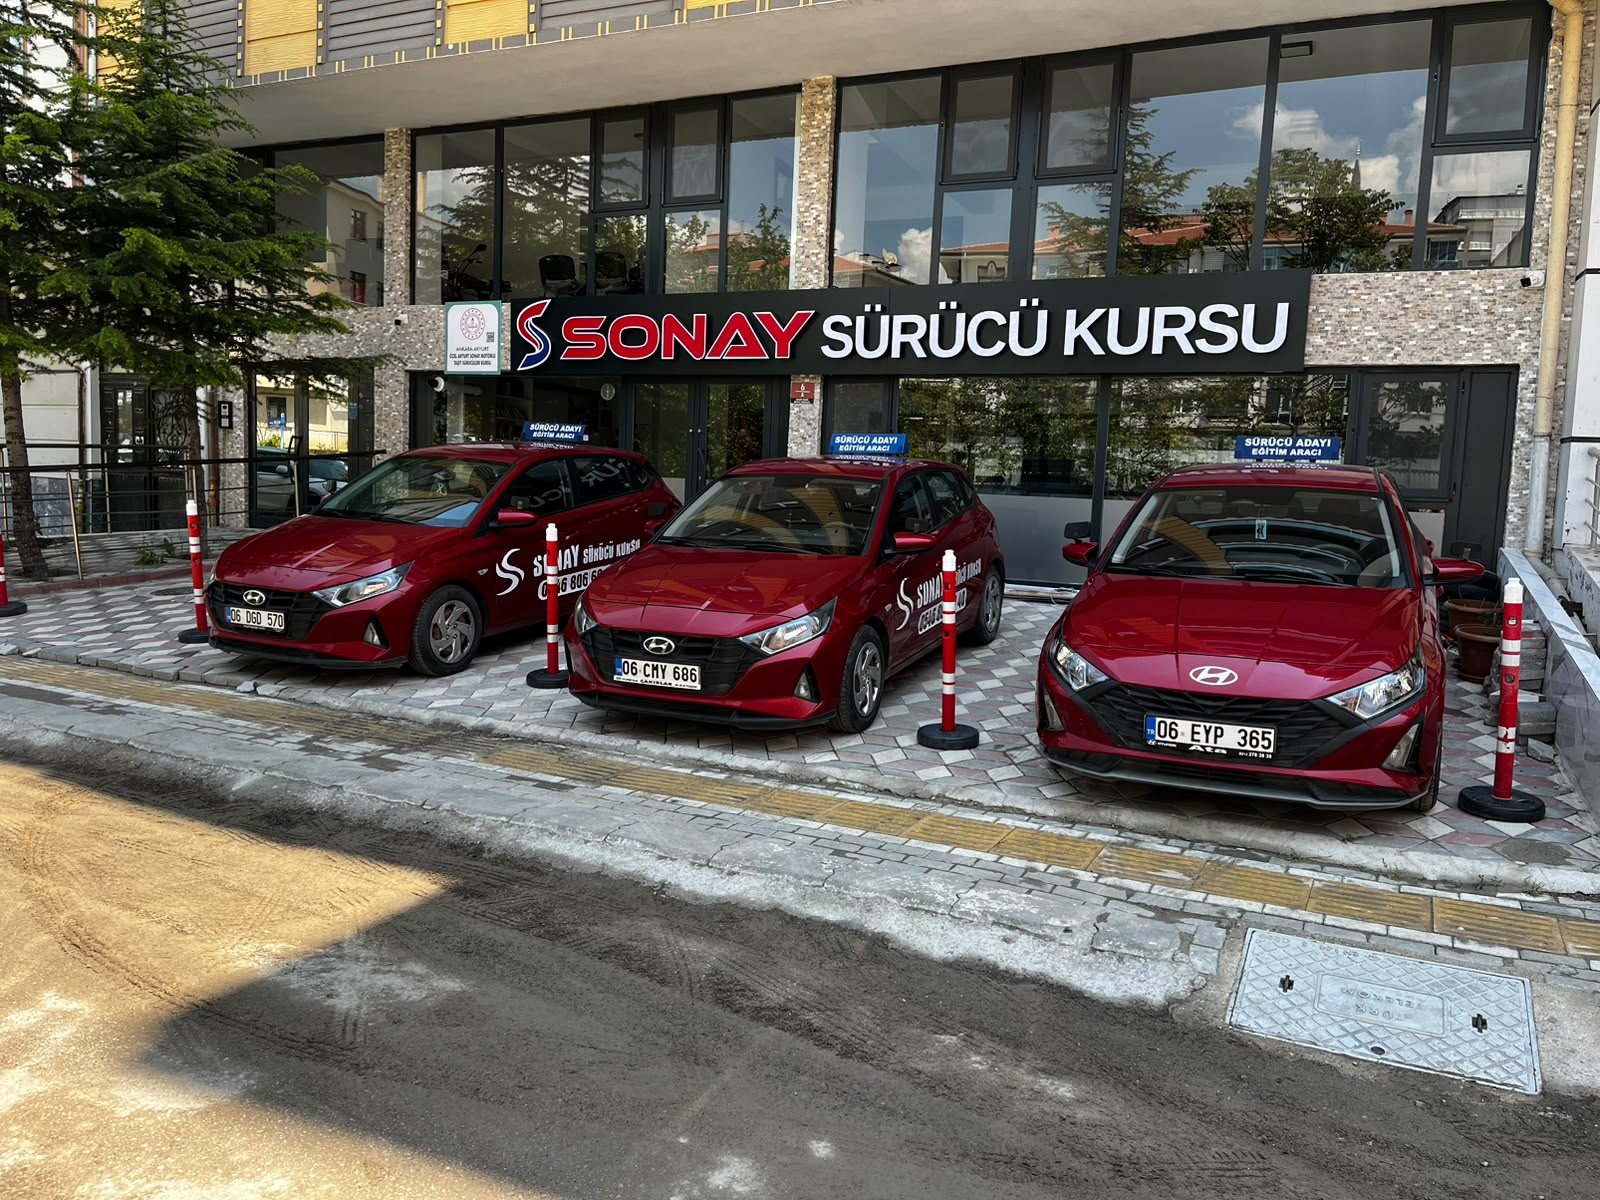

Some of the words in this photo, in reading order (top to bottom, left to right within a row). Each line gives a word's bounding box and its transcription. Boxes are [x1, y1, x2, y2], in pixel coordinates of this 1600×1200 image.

[560, 310, 815, 360] SONAY
[820, 298, 1048, 359] SÜRÜCÜ
[1063, 302, 1290, 356] KURSU
[800, 383, 806, 391] 6
[529, 422, 560, 432] SÜRÜCÜ
[560, 425, 582, 433] ADAYI
[532, 430, 555, 438] EĞİTİM
[834, 435, 870, 444] SÜRÜCÜ
[871, 436, 898, 444] ADAYI
[1244, 437, 1293, 447] SÜRÜCÜ
[1295, 438, 1331, 447] ADAYI
[838, 444, 866, 452] EĞİTİM
[1251, 447, 1287, 456] EĞİTİM
[1289, 448, 1322, 456] ARACI
[541, 577, 567, 598] 06
[570, 574, 588, 591] 806
[230, 608, 241, 622] 06
[246, 610, 262, 625] DGD
[267, 613, 284, 628] 570
[622, 660, 638, 676] 06
[643, 663, 667, 679] CMY
[673, 666, 697, 682] 686
[1157, 720, 1178, 740] 06
[1191, 723, 1224, 744] EYP
[1237, 729, 1272, 750] 365
[1188, 744, 1228, 754] Ata
